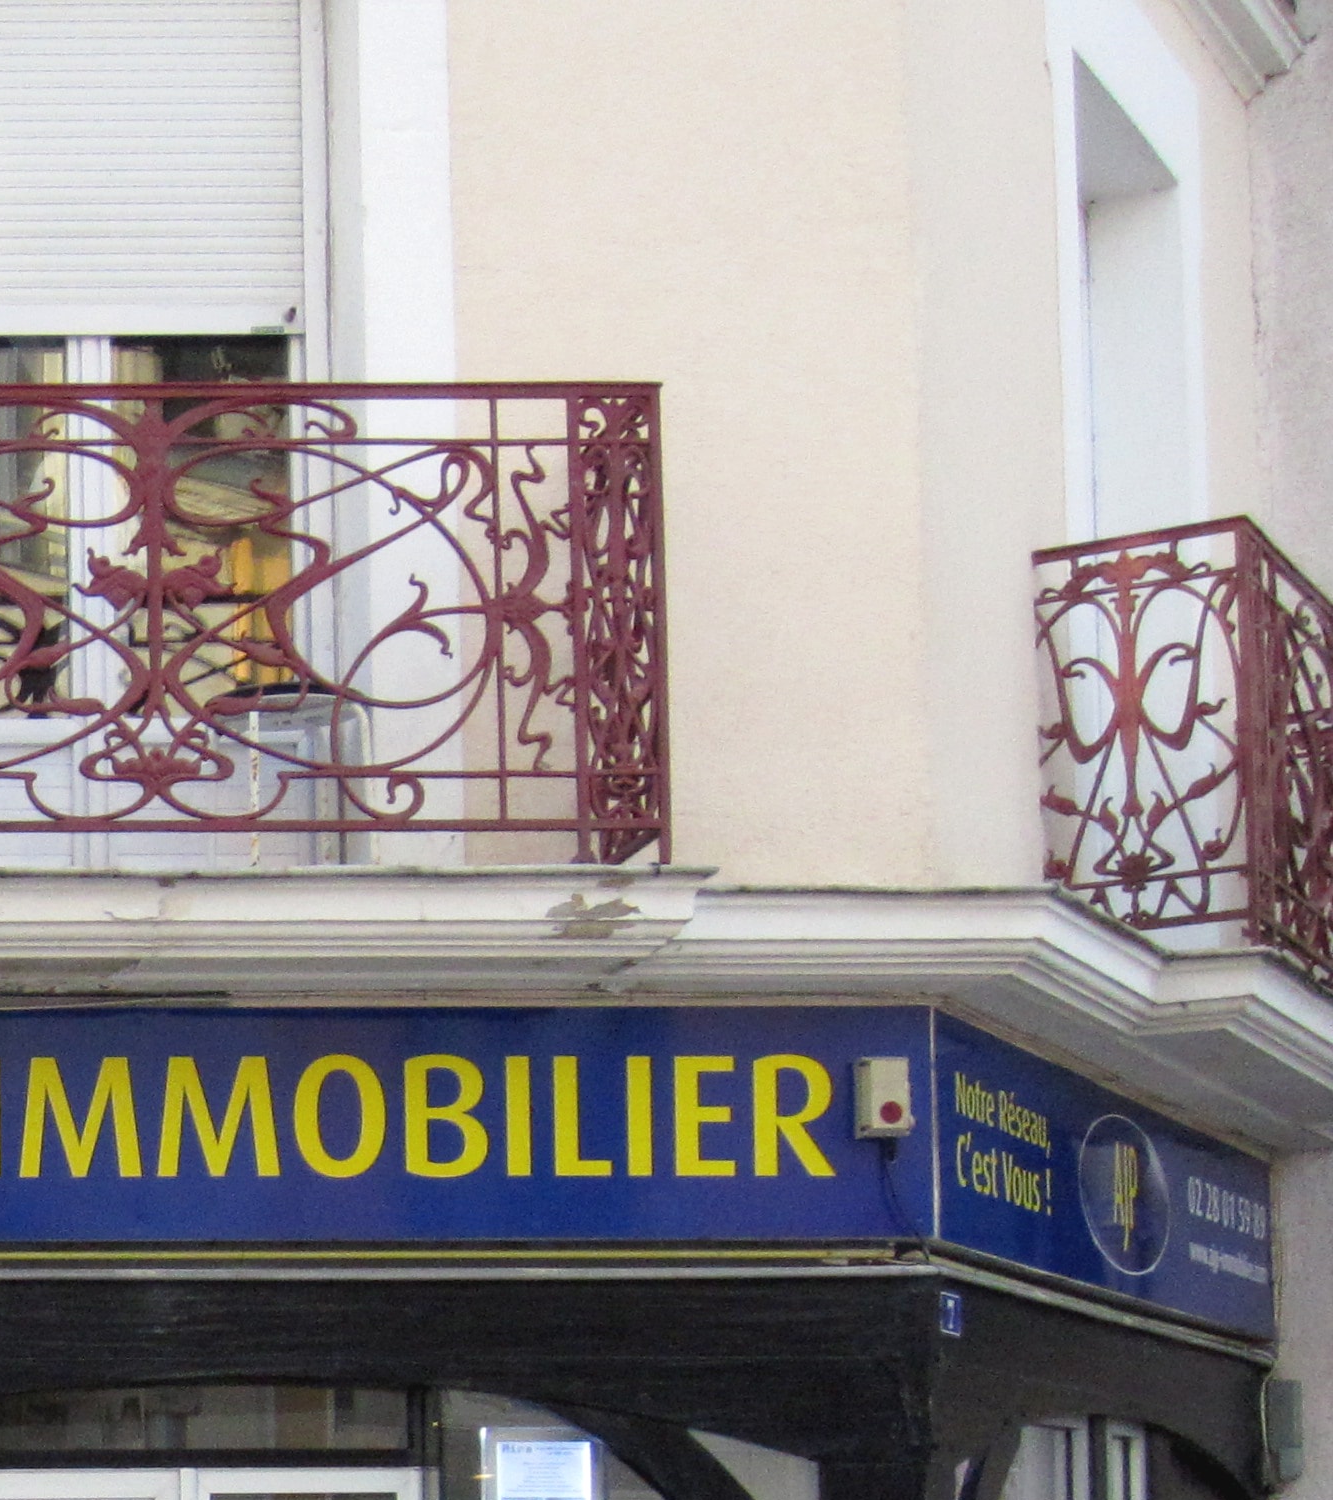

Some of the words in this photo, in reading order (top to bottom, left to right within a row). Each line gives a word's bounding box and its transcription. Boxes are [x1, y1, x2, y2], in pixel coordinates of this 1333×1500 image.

[954, 1070, 996, 1128] Notre
[998, 1089, 1052, 1159] Réseau,
[955, 1131, 999, 1198] C'est
[1001, 1151, 1041, 1213] Vous
[1113, 1140, 1139, 1252] AJP
